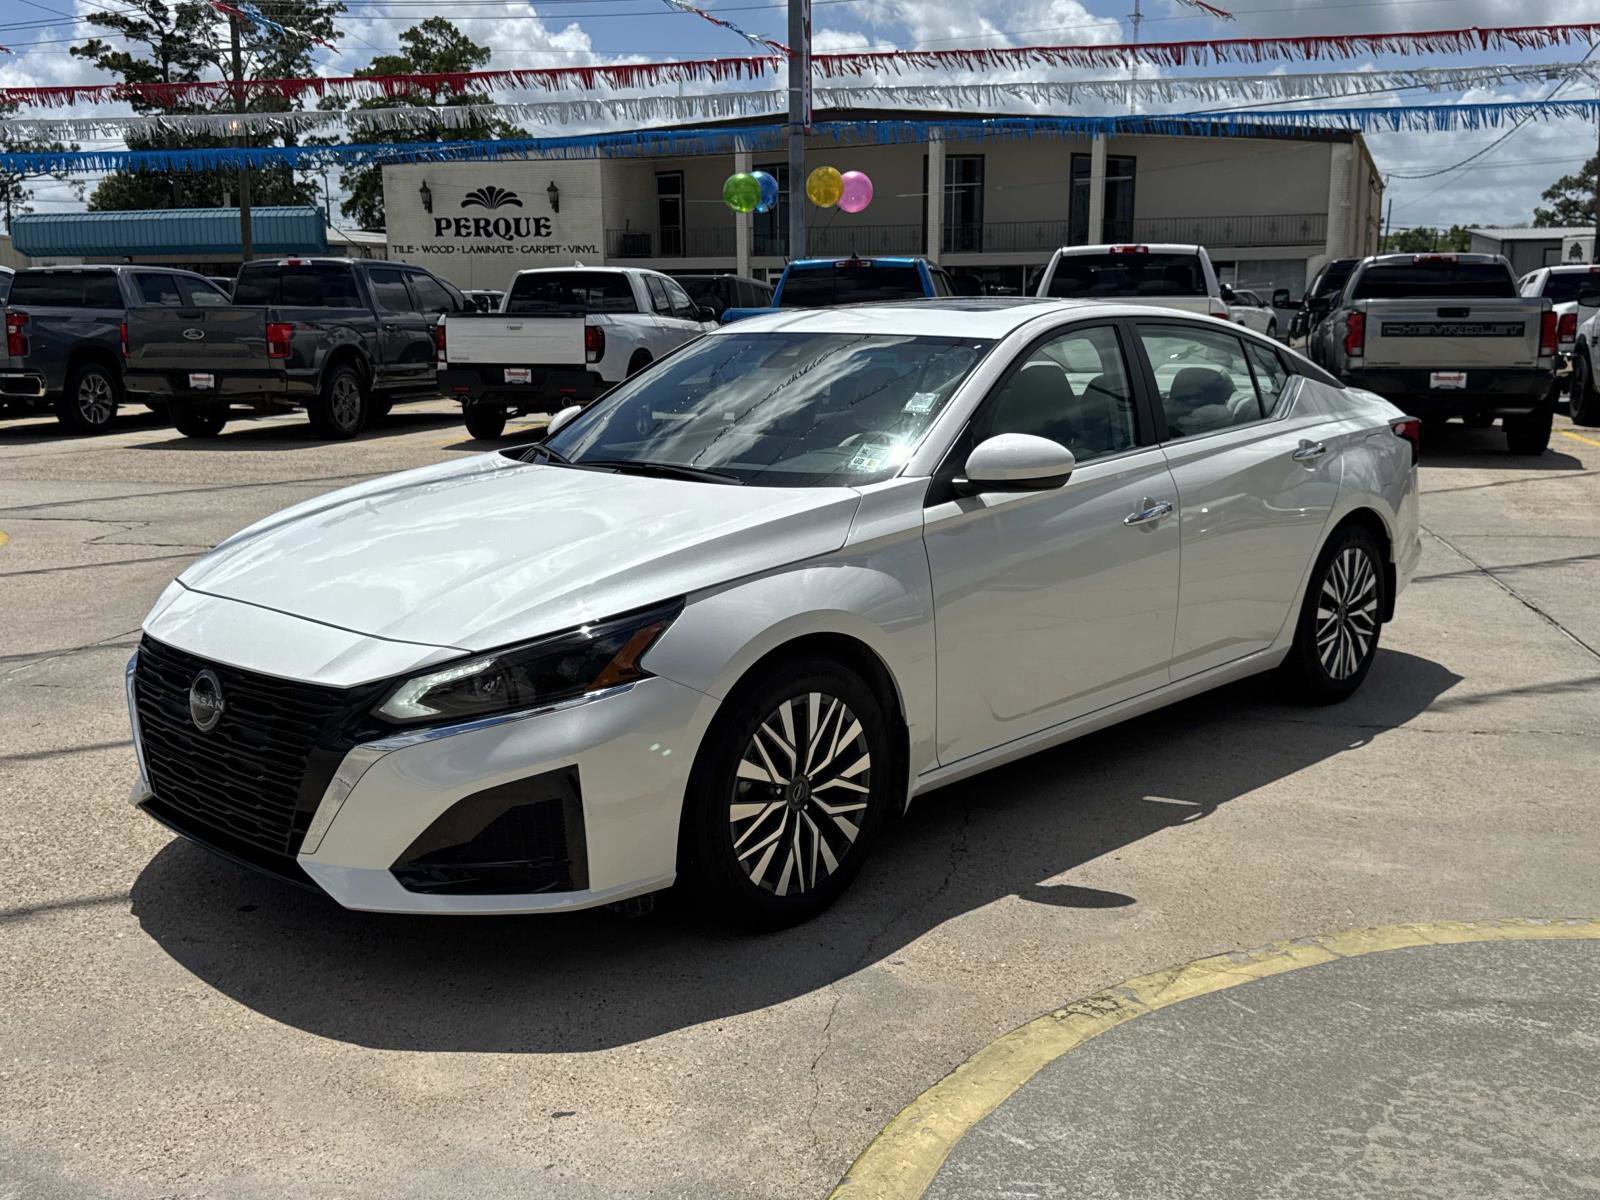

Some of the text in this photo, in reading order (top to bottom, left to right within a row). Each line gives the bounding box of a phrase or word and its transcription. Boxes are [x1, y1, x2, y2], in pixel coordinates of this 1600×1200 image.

[434, 217, 552, 240] PERQUE
[392, 245, 600, 254] TILE WOOD LAMINATE CARPET VINYL
[1383, 324, 1523, 335] CHEVROLET
